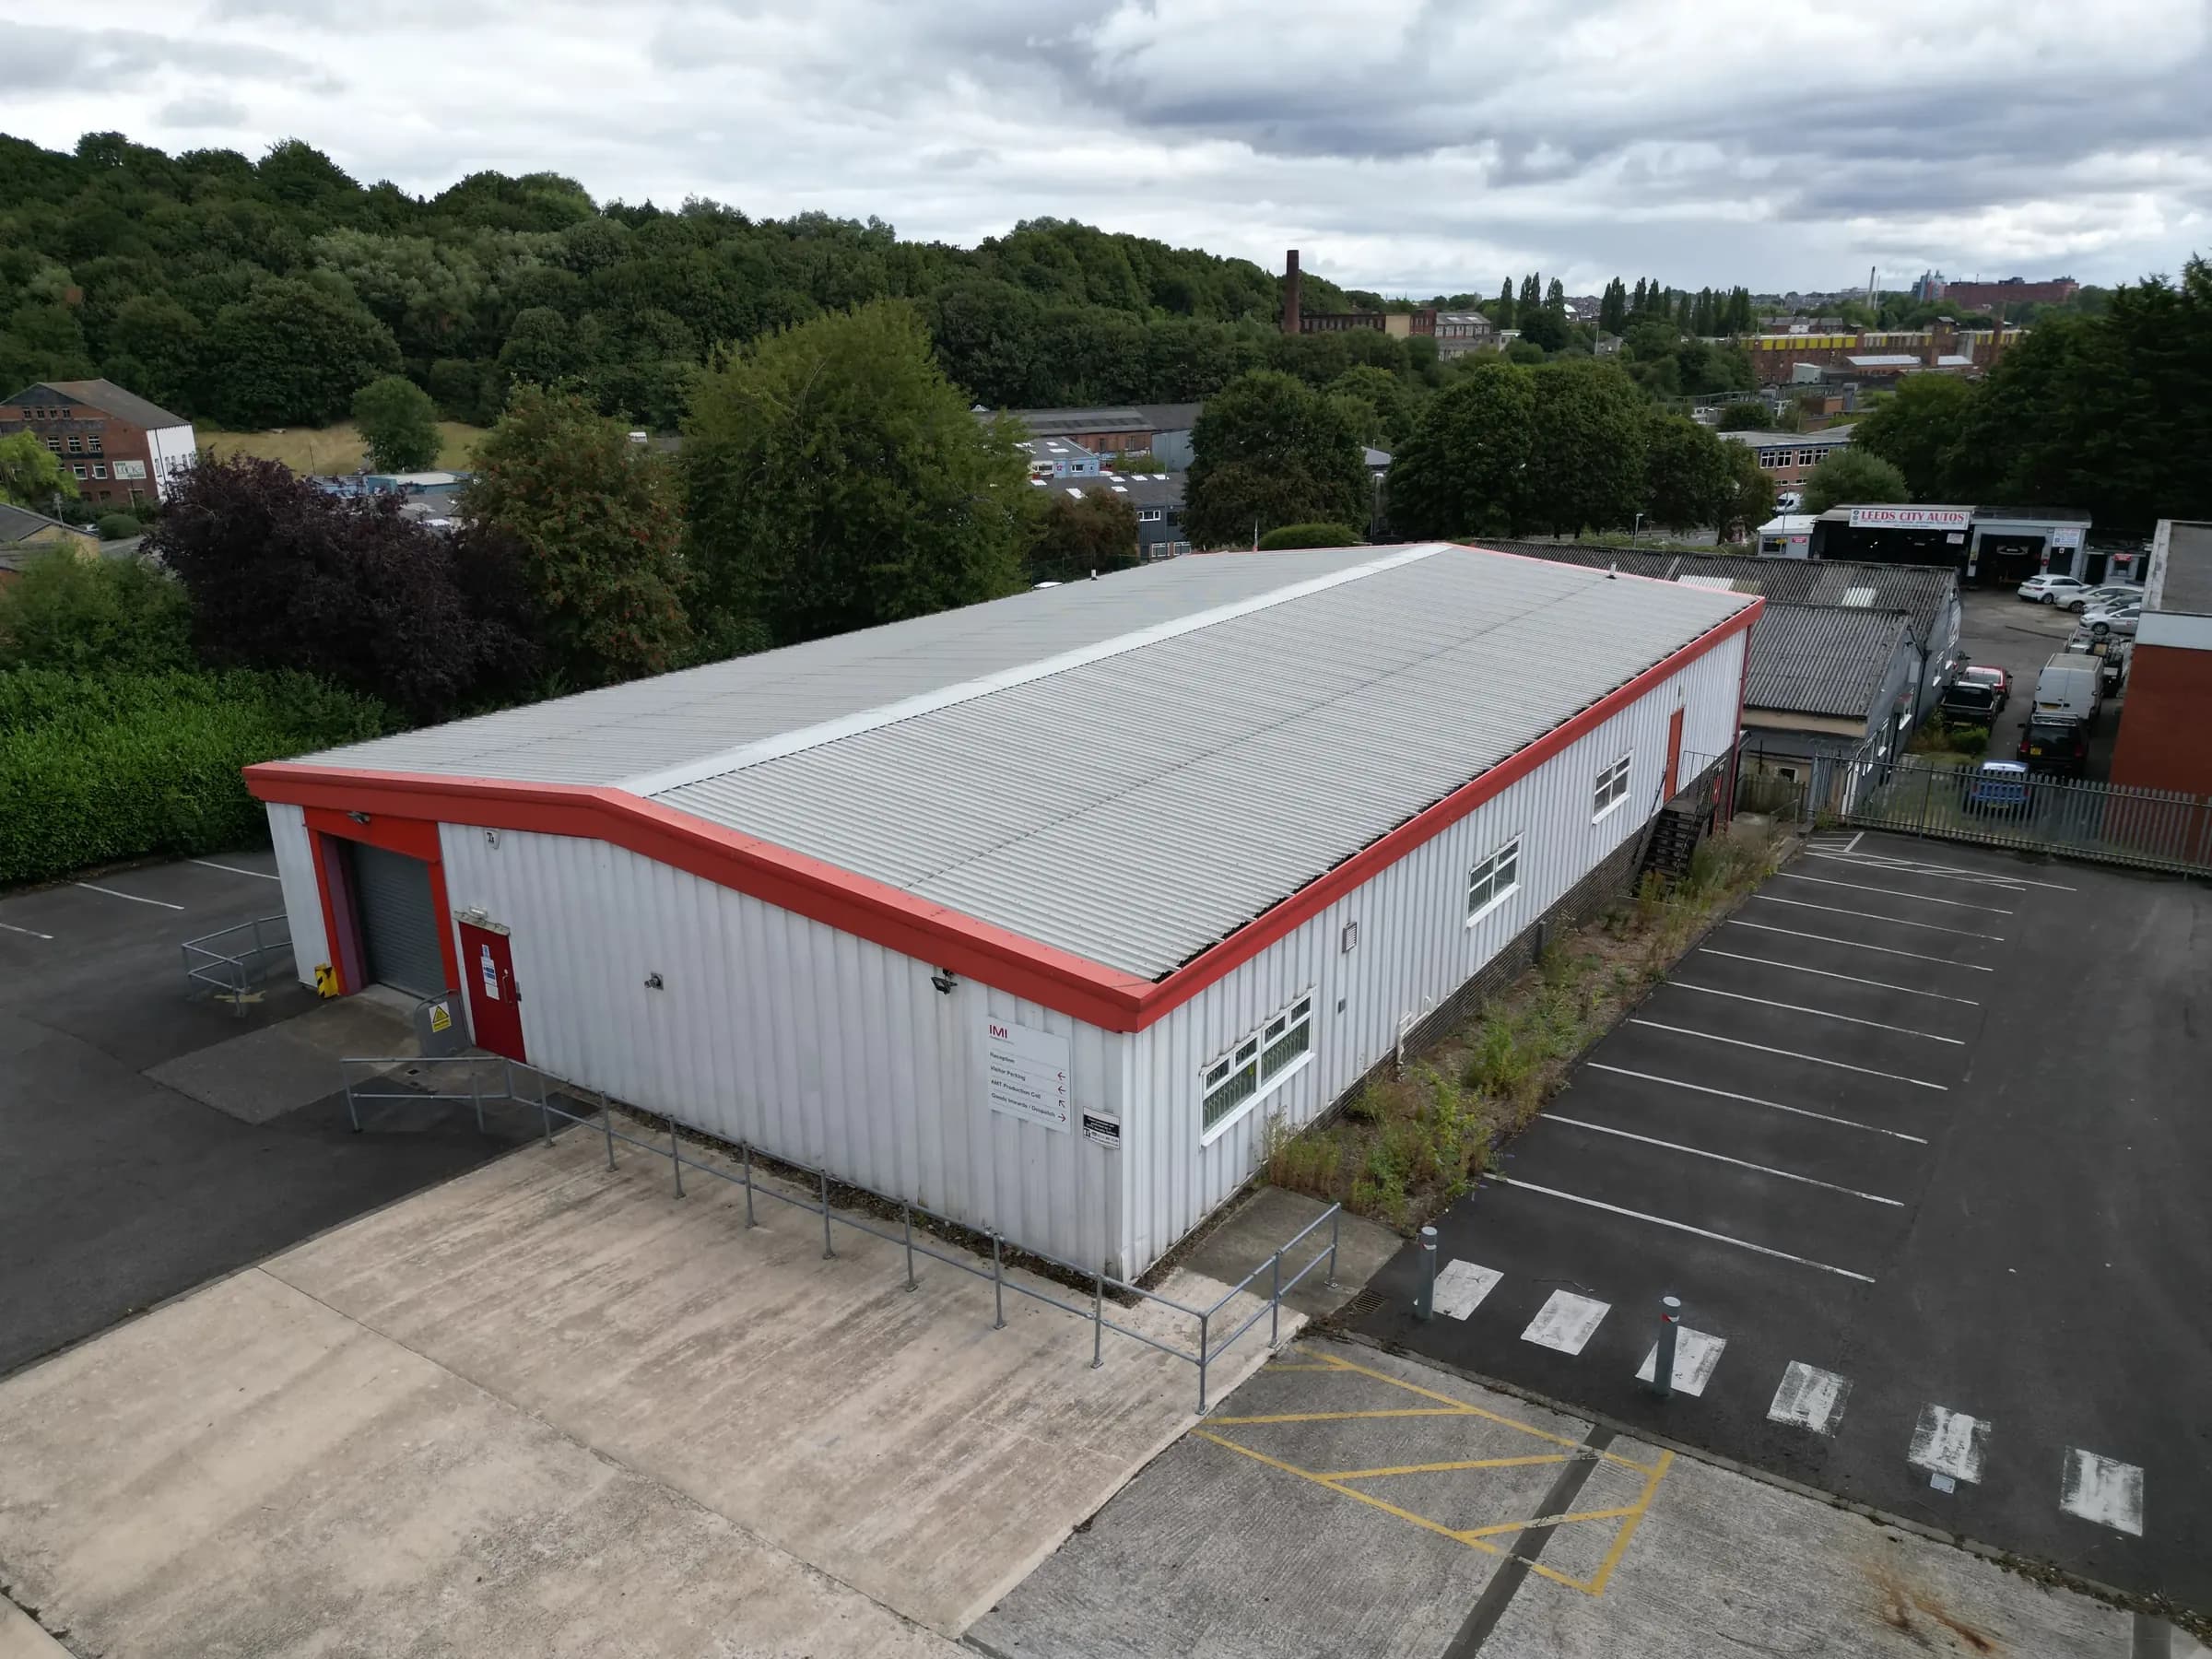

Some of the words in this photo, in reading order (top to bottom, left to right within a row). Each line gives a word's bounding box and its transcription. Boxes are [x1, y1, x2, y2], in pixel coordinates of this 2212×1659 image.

[1861, 511, 1895, 520] LEEDS
[1900, 512, 1924, 521] CITY
[1927, 512, 1964, 522] AUTOS
[989, 1024, 1007, 1039] IMI
[990, 1052, 1015, 1063] Reception
[990, 1065, 1006, 1075] Visitor
[1006, 1070, 1026, 1081] Parking
[1003, 1082, 1030, 1096] Production
[991, 1092, 1007, 1103] Goods
